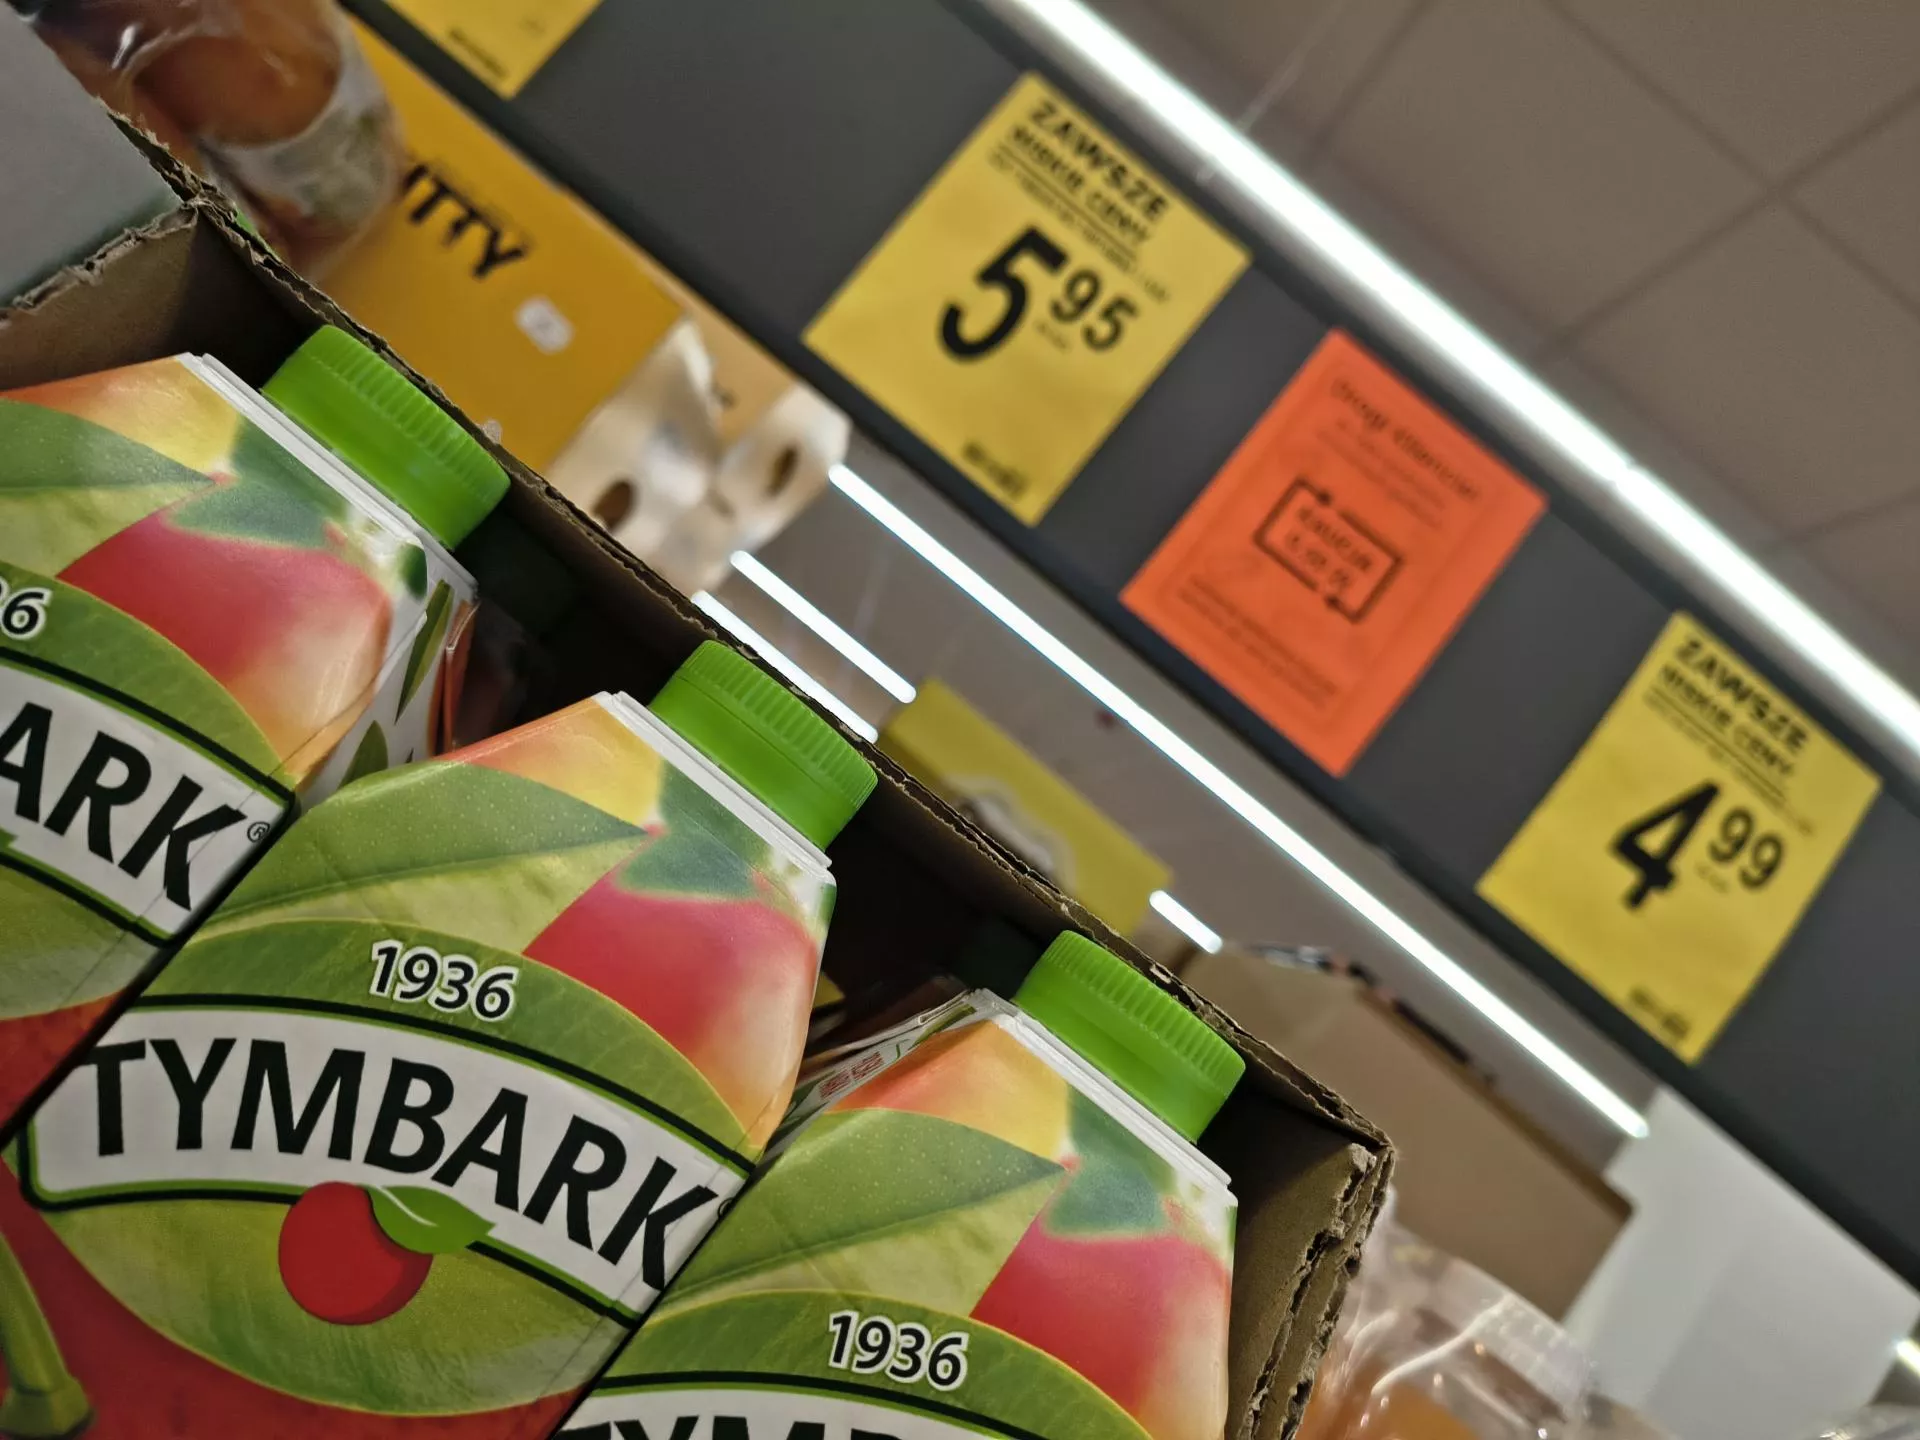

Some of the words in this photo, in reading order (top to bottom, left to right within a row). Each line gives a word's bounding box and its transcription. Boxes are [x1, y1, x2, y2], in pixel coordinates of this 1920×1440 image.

[1028, 98, 1170, 226] ZAWSZE
[934, 222, 1071, 367] 5
[1049, 264, 1142, 356] 95
[0, 575, 52, 640] 6
[1673, 633, 1809, 756] ZAWSZE
[1606, 777, 1723, 915] 4
[1705, 802, 1788, 894] 99
[369, 938, 520, 1023] 1936
[76, 1036, 718, 1291] TYMBARK
[828, 1309, 970, 1393] 1936
